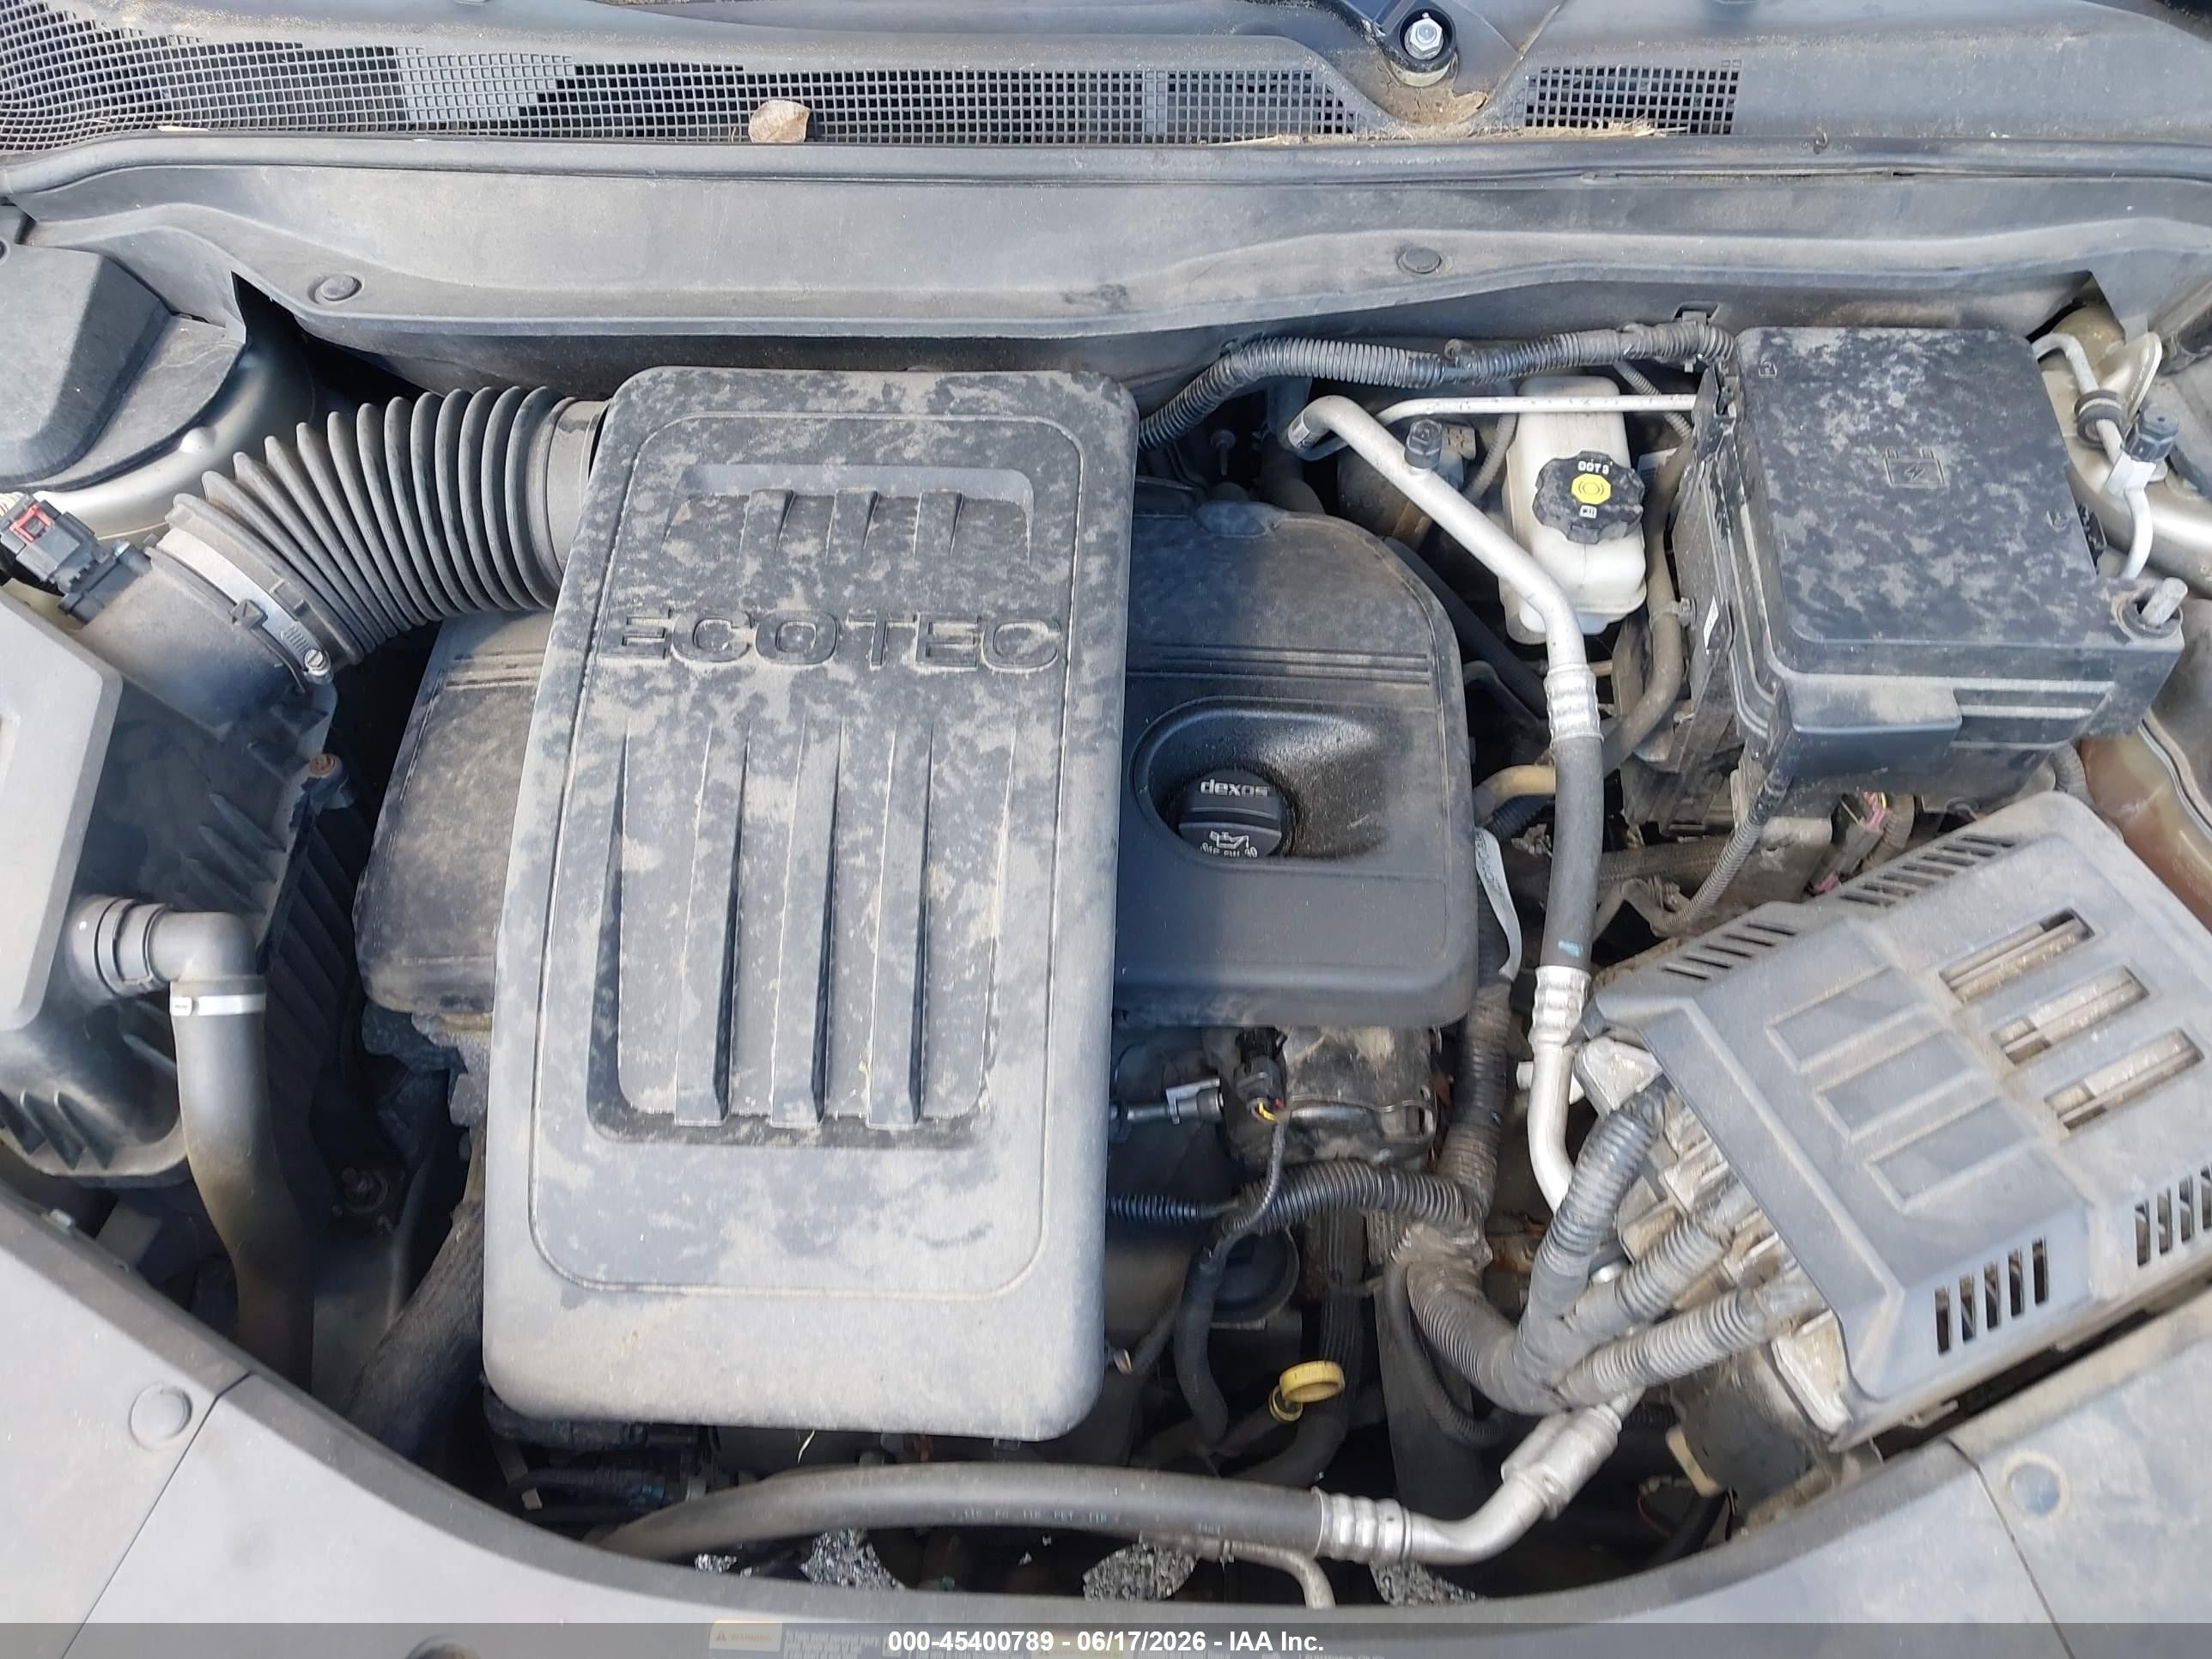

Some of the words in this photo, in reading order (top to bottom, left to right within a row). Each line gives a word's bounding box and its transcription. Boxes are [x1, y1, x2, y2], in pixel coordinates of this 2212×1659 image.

[1578, 460, 1601, 473] DOT
[601, 608, 1062, 672] ECOTEC
[1200, 779, 1268, 797] dexos
